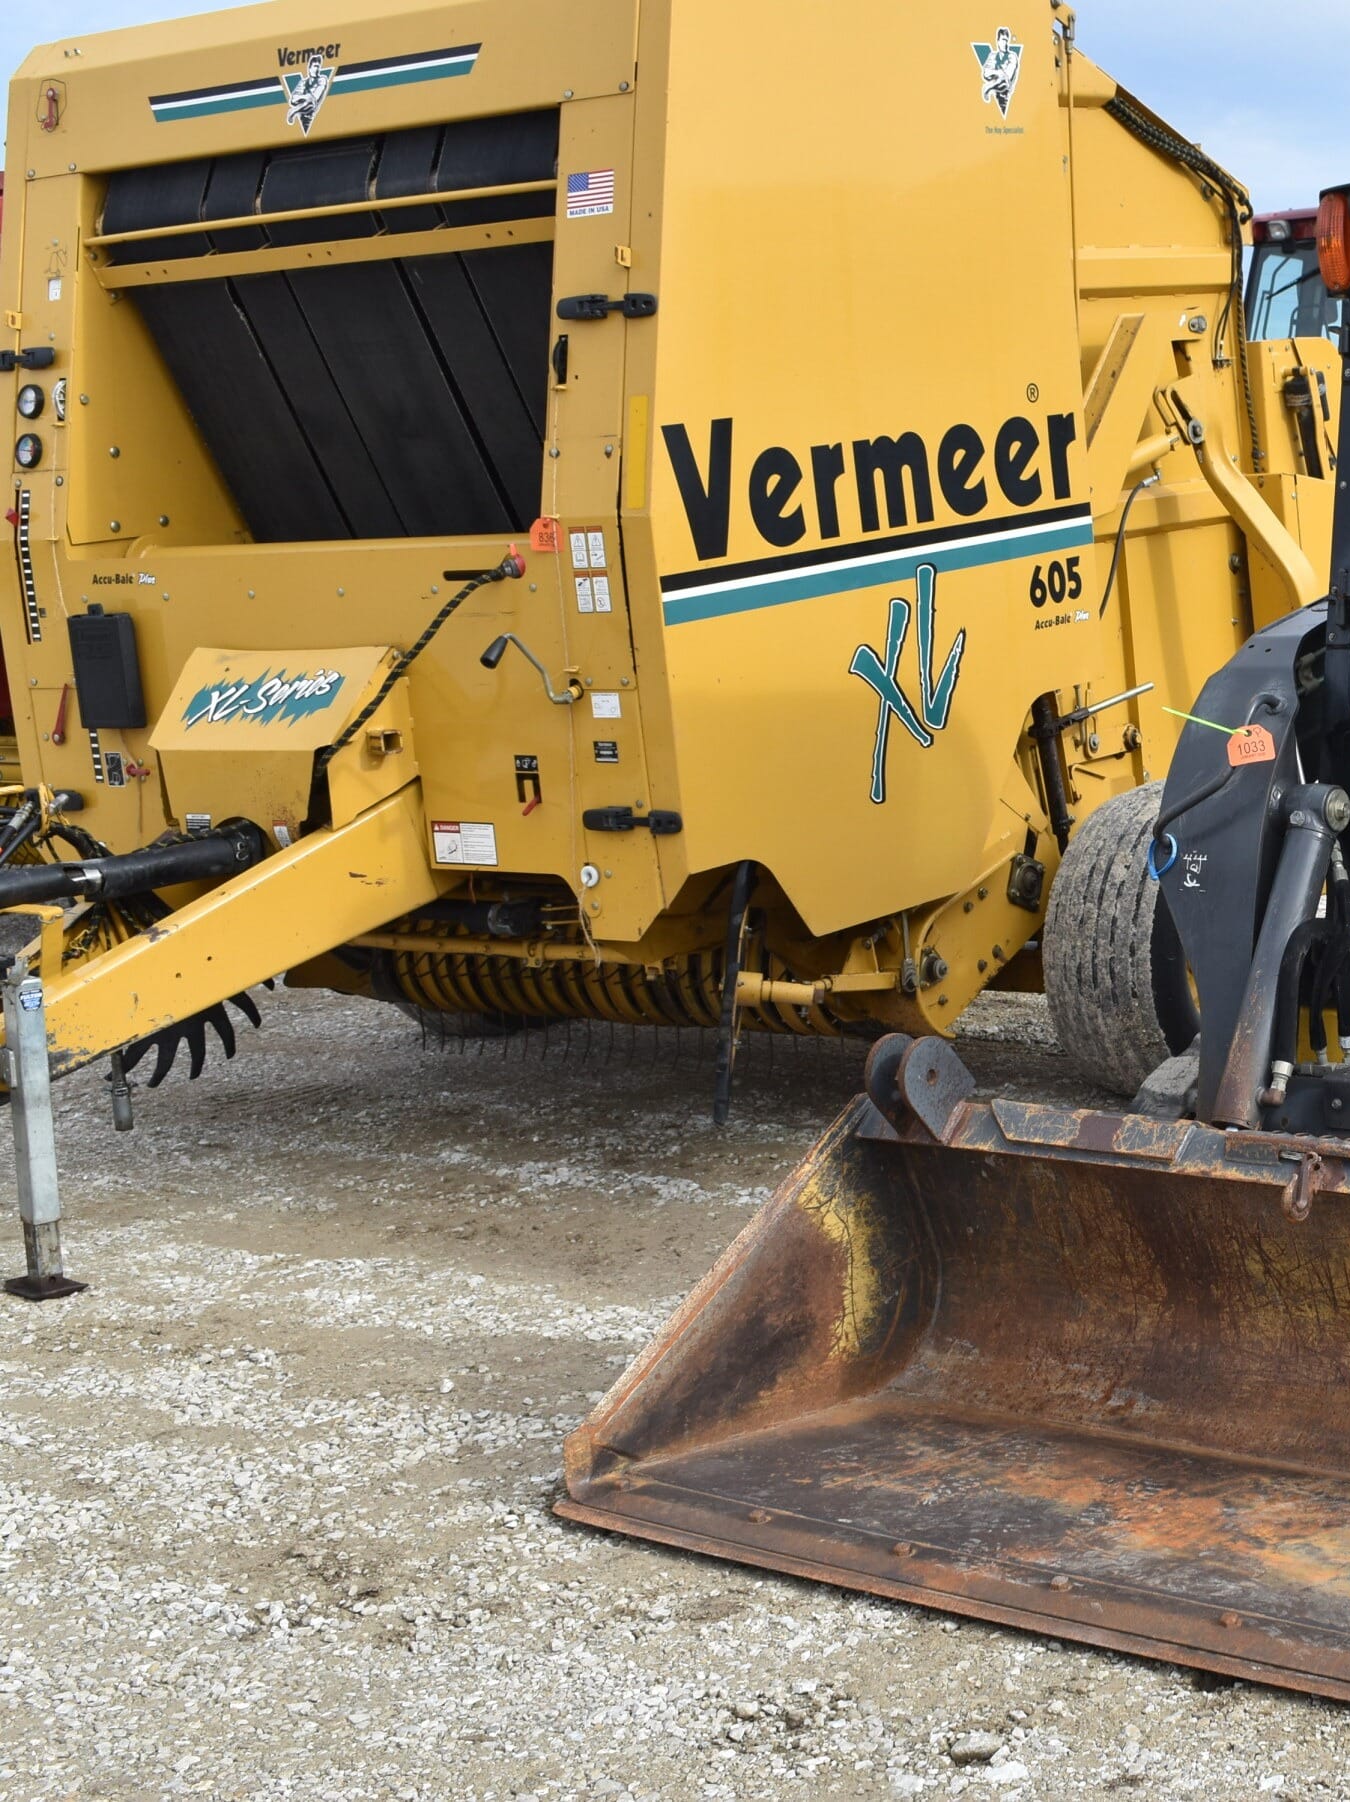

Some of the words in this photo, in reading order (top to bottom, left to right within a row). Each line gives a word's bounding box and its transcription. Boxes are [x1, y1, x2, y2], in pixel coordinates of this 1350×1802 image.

[277, 43, 341, 67] Vermeer
[569, 208, 587, 216] MADE
[661, 412, 1076, 561] Vermeer
[92, 573, 133, 584] Accu-Bale
[1030, 556, 1082, 608] 605
[1035, 613, 1071, 630] Accu-Bale
[848, 562, 966, 804] XL
[187, 667, 340, 726] XL-Series
[1238, 740, 1265, 755] 1033
